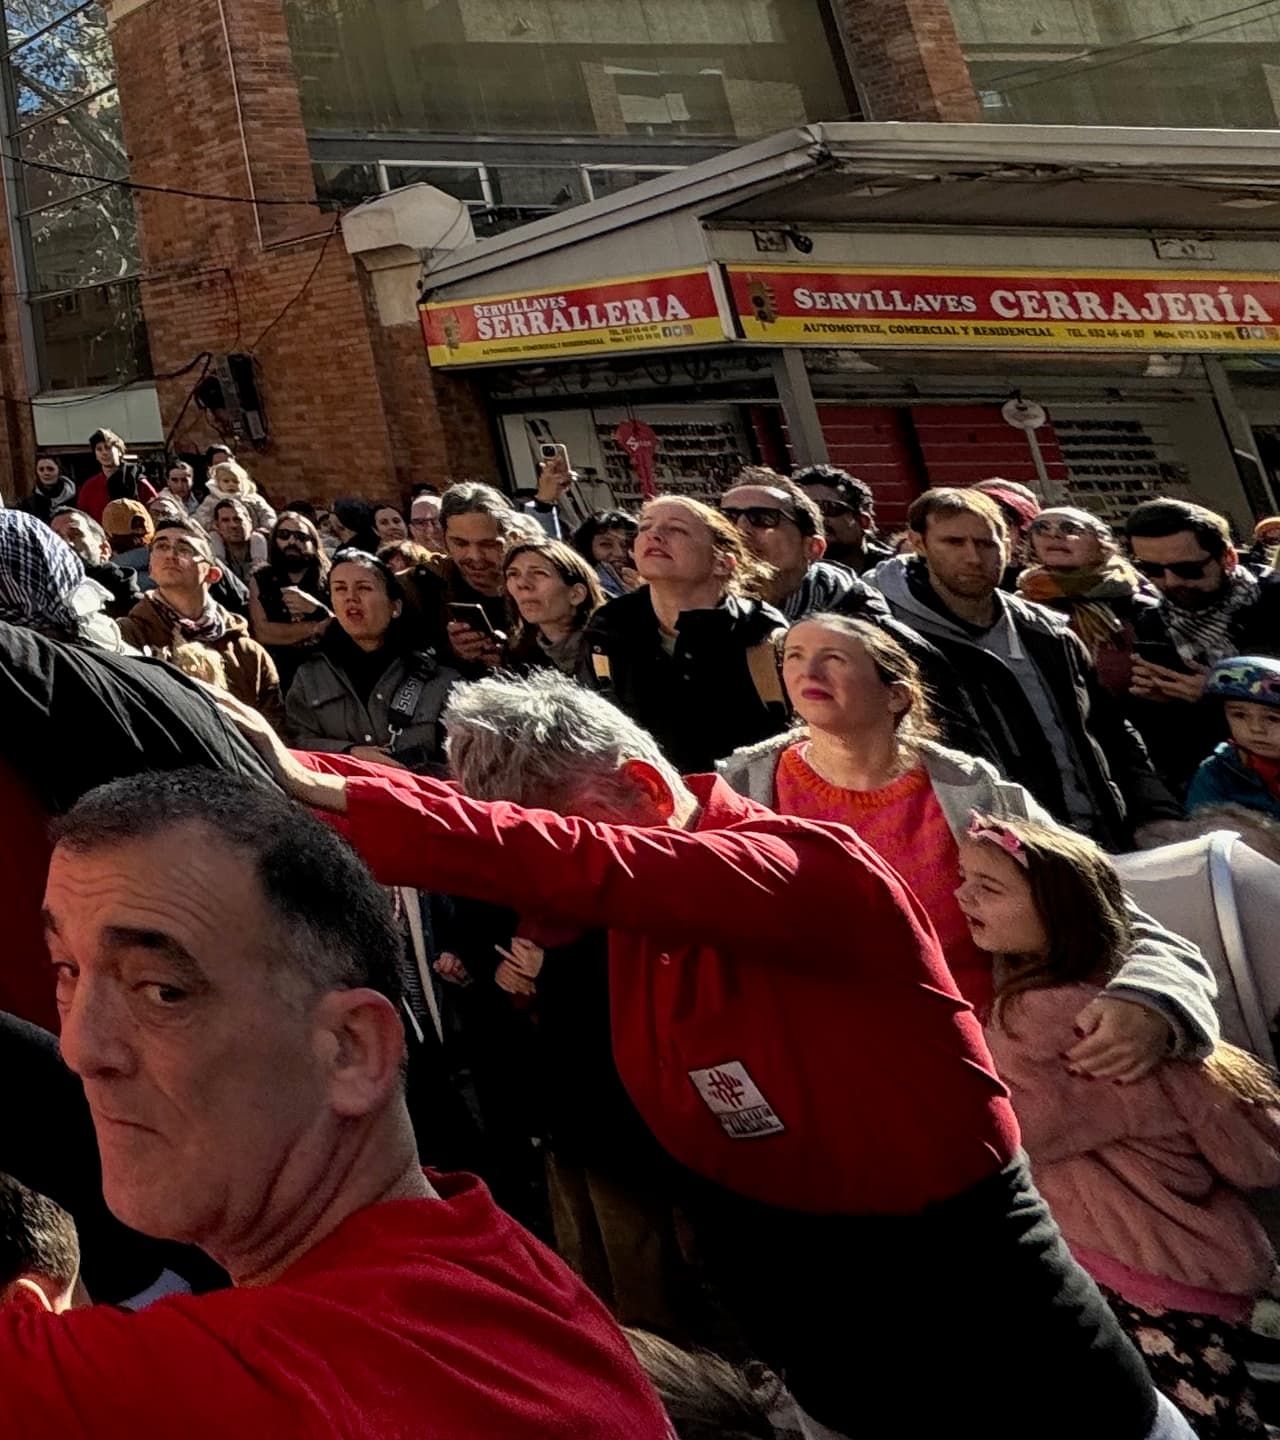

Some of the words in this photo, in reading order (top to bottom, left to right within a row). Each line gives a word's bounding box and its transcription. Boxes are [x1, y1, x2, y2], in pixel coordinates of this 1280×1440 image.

[477, 294, 690, 340] SERRALLERIA
[990, 285, 1273, 322] CERRAJERÍA
[889, 324, 959, 335] COMERCIAL
